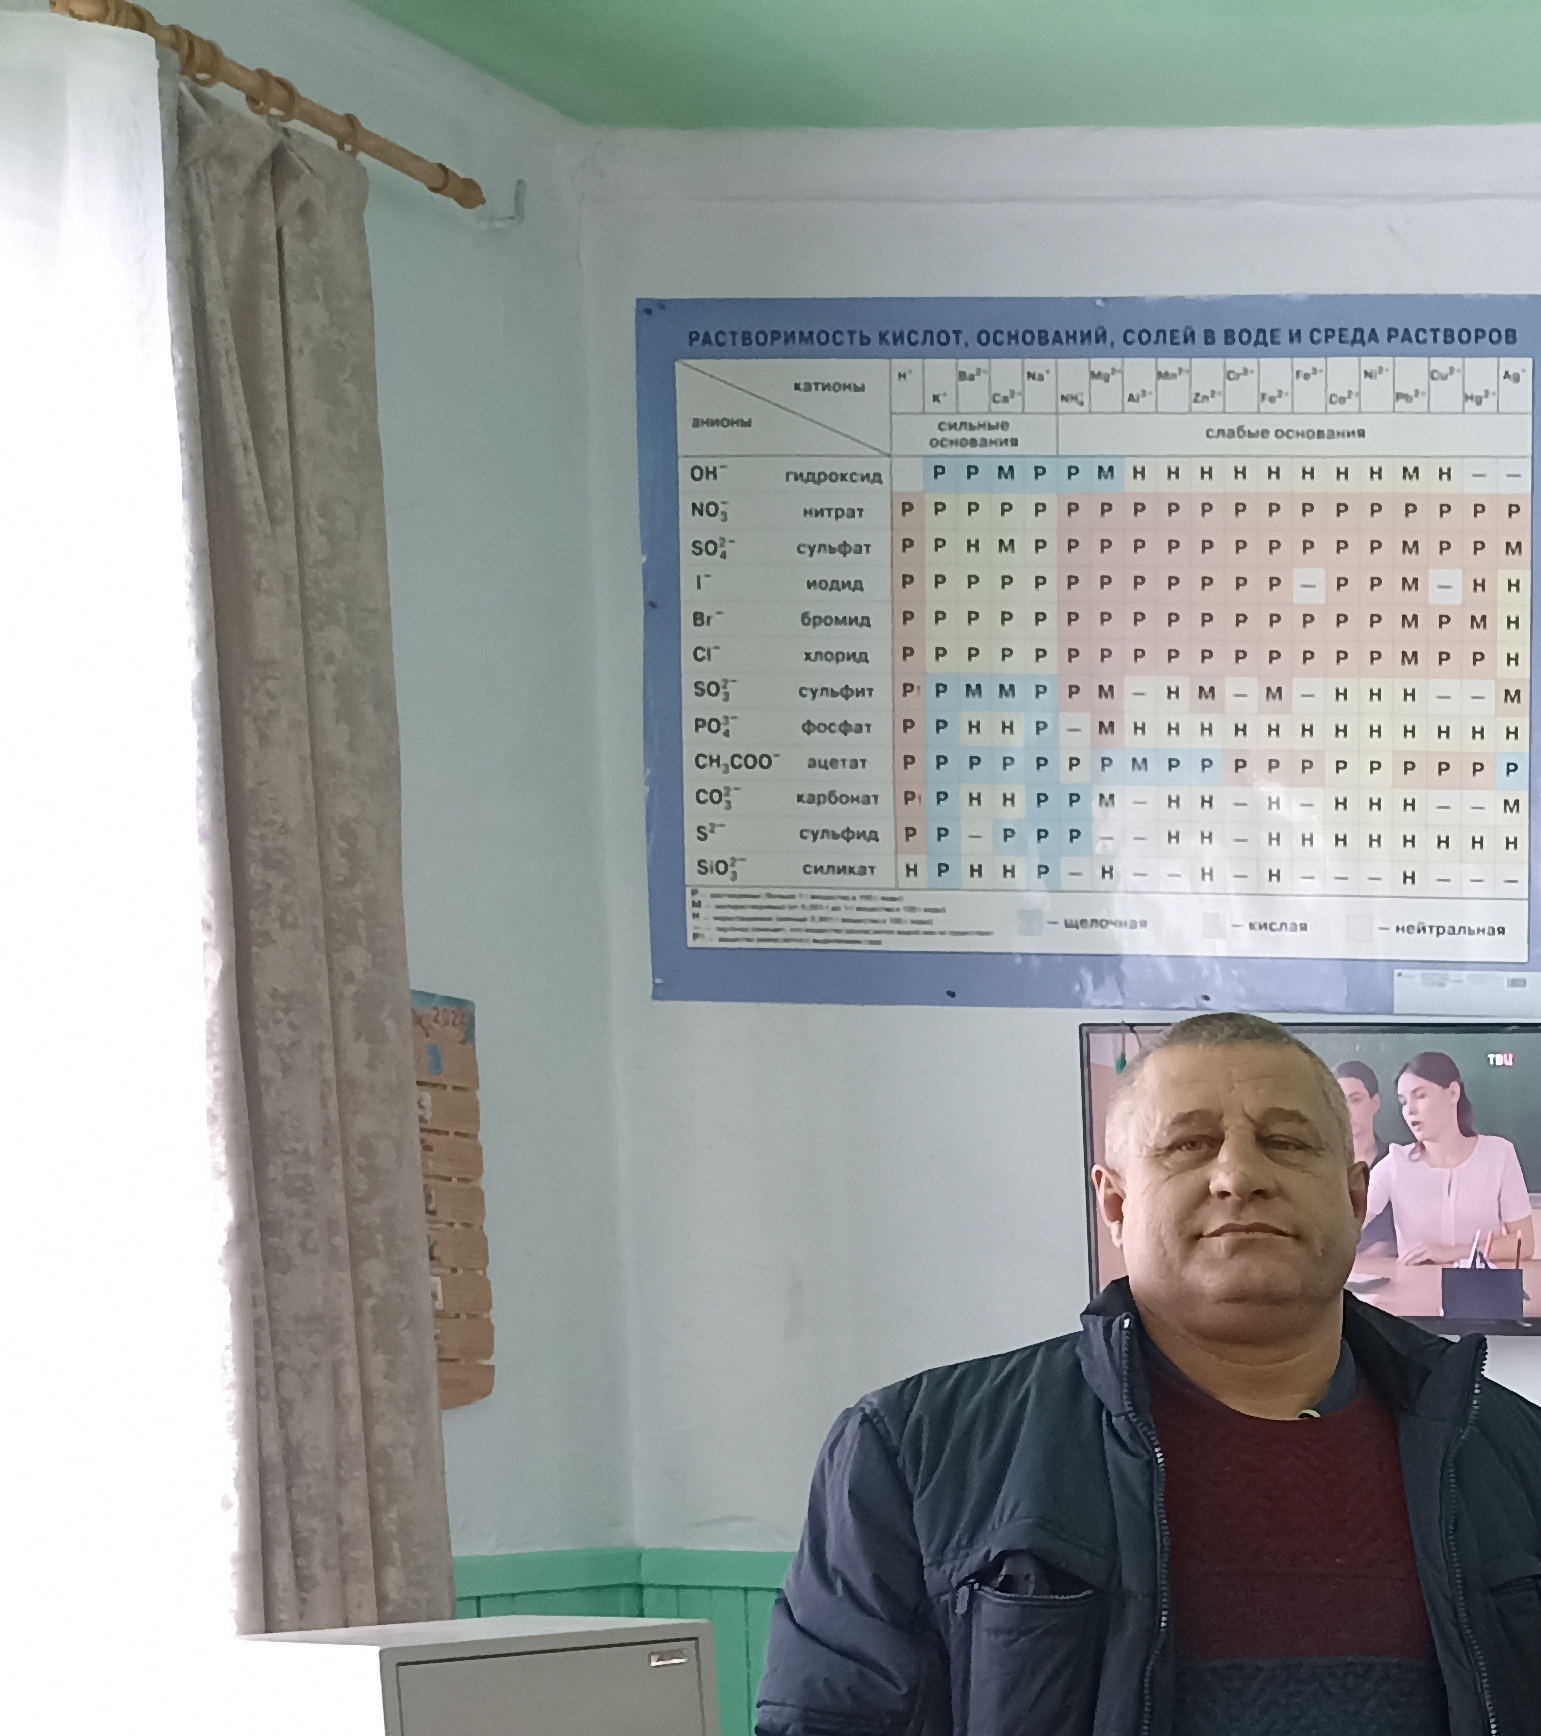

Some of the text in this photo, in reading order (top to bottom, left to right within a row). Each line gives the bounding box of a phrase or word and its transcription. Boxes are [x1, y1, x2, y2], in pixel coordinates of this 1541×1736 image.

[688, 324, 1518, 349] РАСТВОРИМОСТЬ КИСЛОТ, ОСНОВАНИЙ, СОЛЕЙ В ВОДЕ И СРЕДА РАСТВОРОВ
[794, 380, 865, 393] катионы
[691, 417, 752, 428] анионы
[937, 419, 1010, 432] сильные
[1206, 426, 1365, 440] слабые основания
[929, 437, 1019, 448] основания
[785, 471, 883, 485] гидроксид
[803, 507, 864, 520] нитрат
[797, 541, 872, 557] сульфат
[806, 579, 864, 592] иодид
[800, 611, 871, 629] бромид
[804, 651, 869, 664] хлорид
[799, 684, 874, 701] сульфит
[801, 720, 872, 736] фосфат
[807, 758, 867, 770] ацетат
[797, 789, 879, 805] карбонат
[799, 827, 879, 842] сульфид
[803, 863, 877, 876] силикат
[1248, 918, 1308, 932] кислая
[1395, 921, 1505, 937] нейтральная
